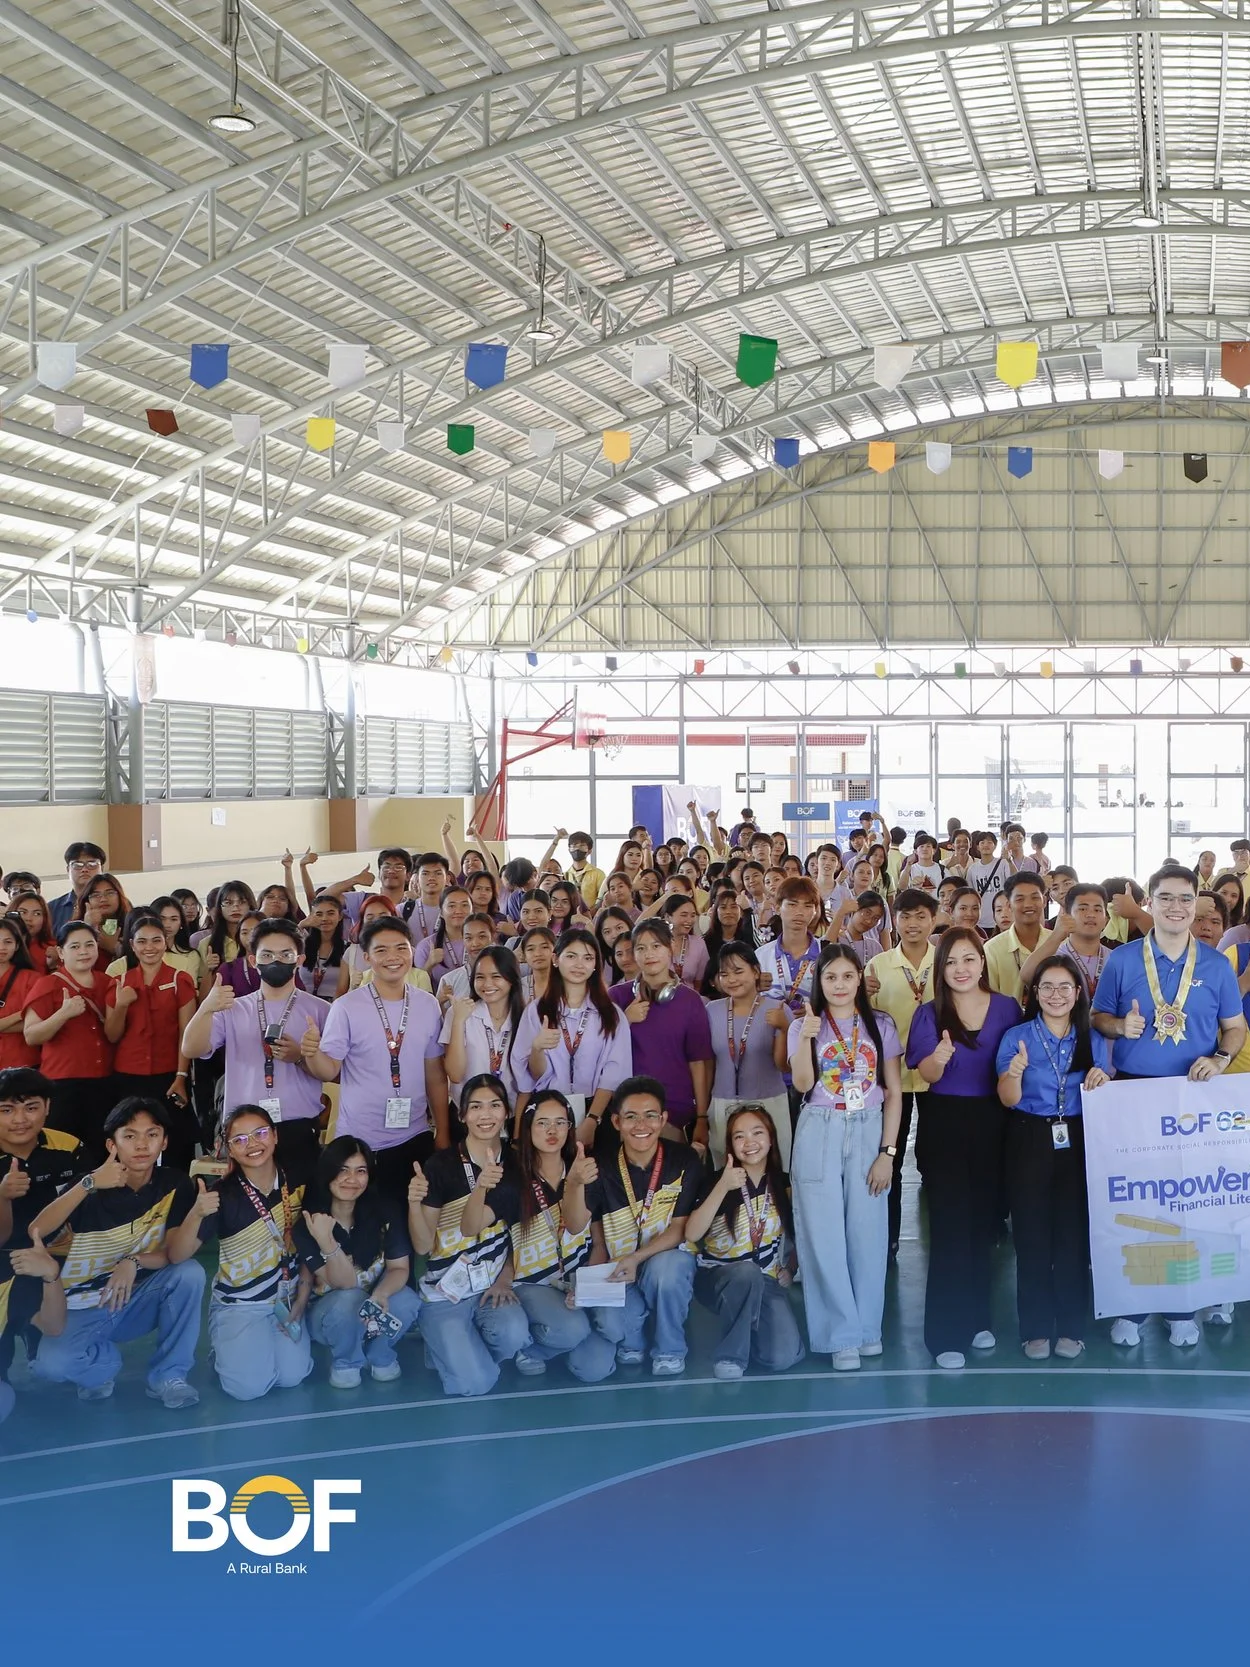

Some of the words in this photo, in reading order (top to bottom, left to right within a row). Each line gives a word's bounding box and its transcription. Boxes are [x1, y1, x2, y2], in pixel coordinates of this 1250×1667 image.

[797, 807, 815, 815] BOF
[976, 876, 1001, 892] NC
[1161, 1113, 1212, 1136] BOF
[1132, 1145, 1174, 1153] CORPORATE
[1177, 1142, 1200, 1150] SOCIAL
[1169, 1195, 1226, 1213] Financial
